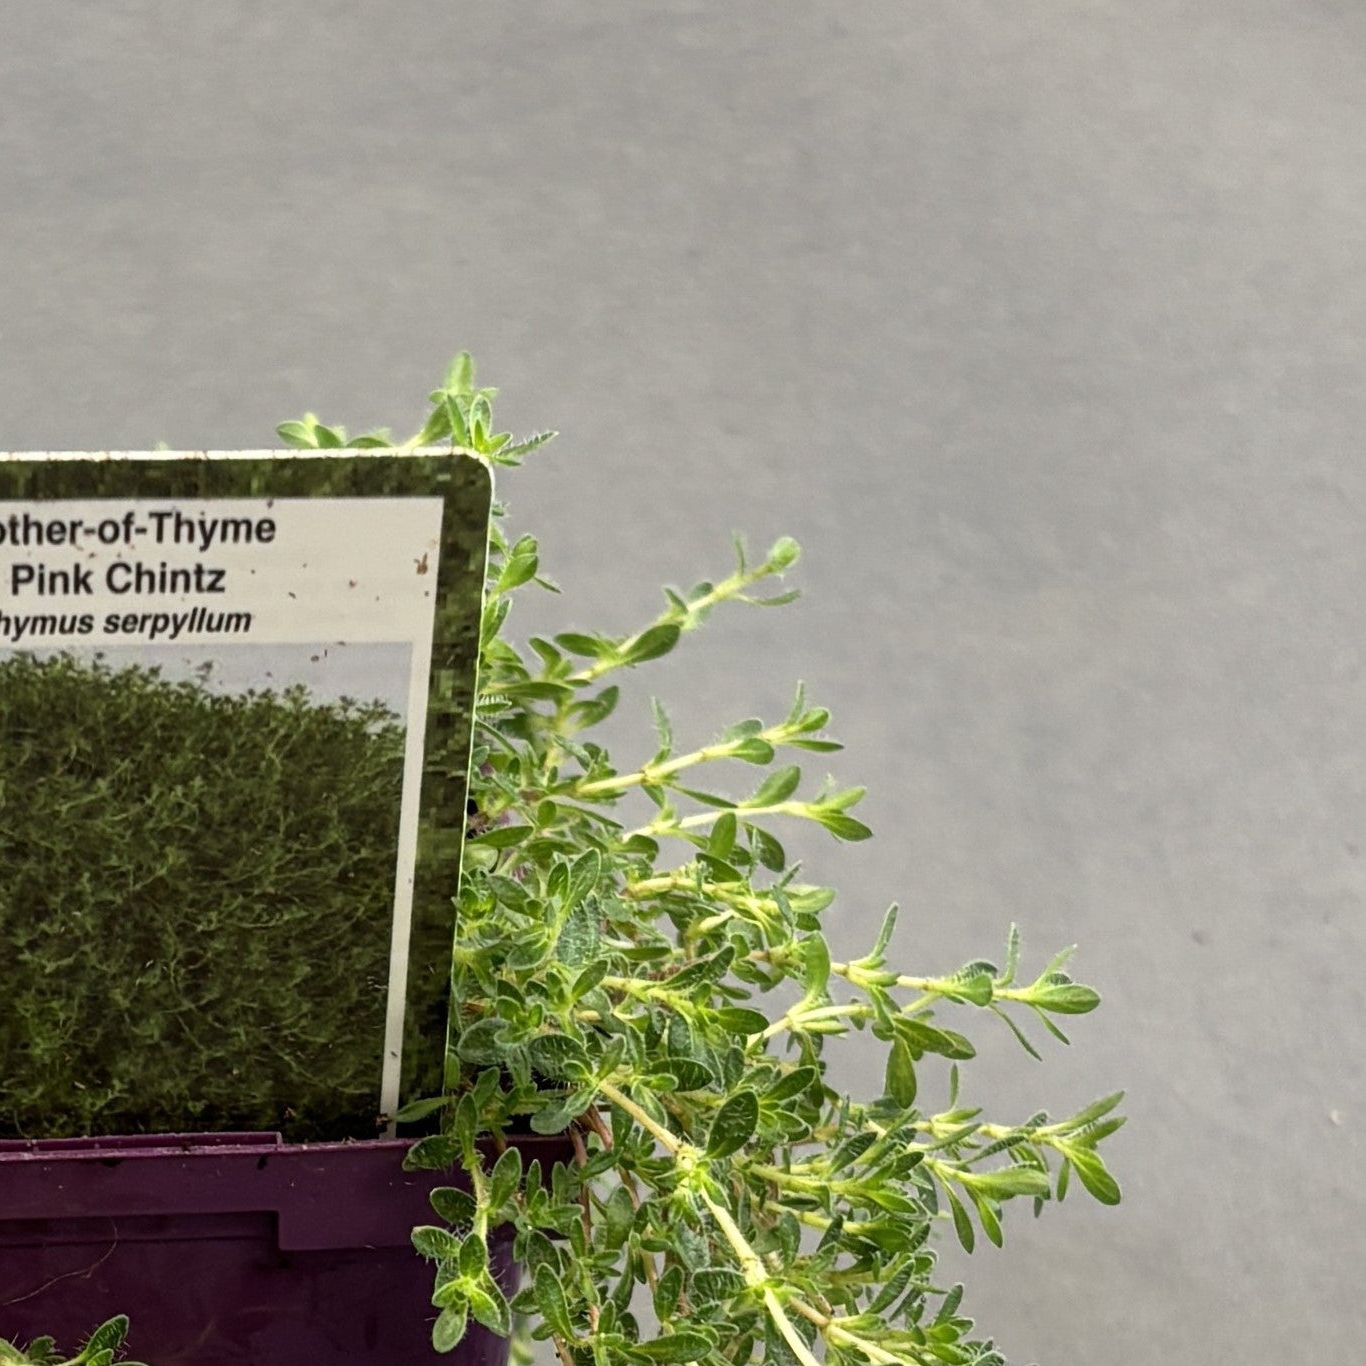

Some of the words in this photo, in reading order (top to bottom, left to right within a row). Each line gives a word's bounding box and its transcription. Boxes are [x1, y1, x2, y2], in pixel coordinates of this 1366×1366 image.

[10, 563, 93, 596] Pink
[105, 561, 227, 595] Chintz
[102, 606, 253, 639] serpyllum
